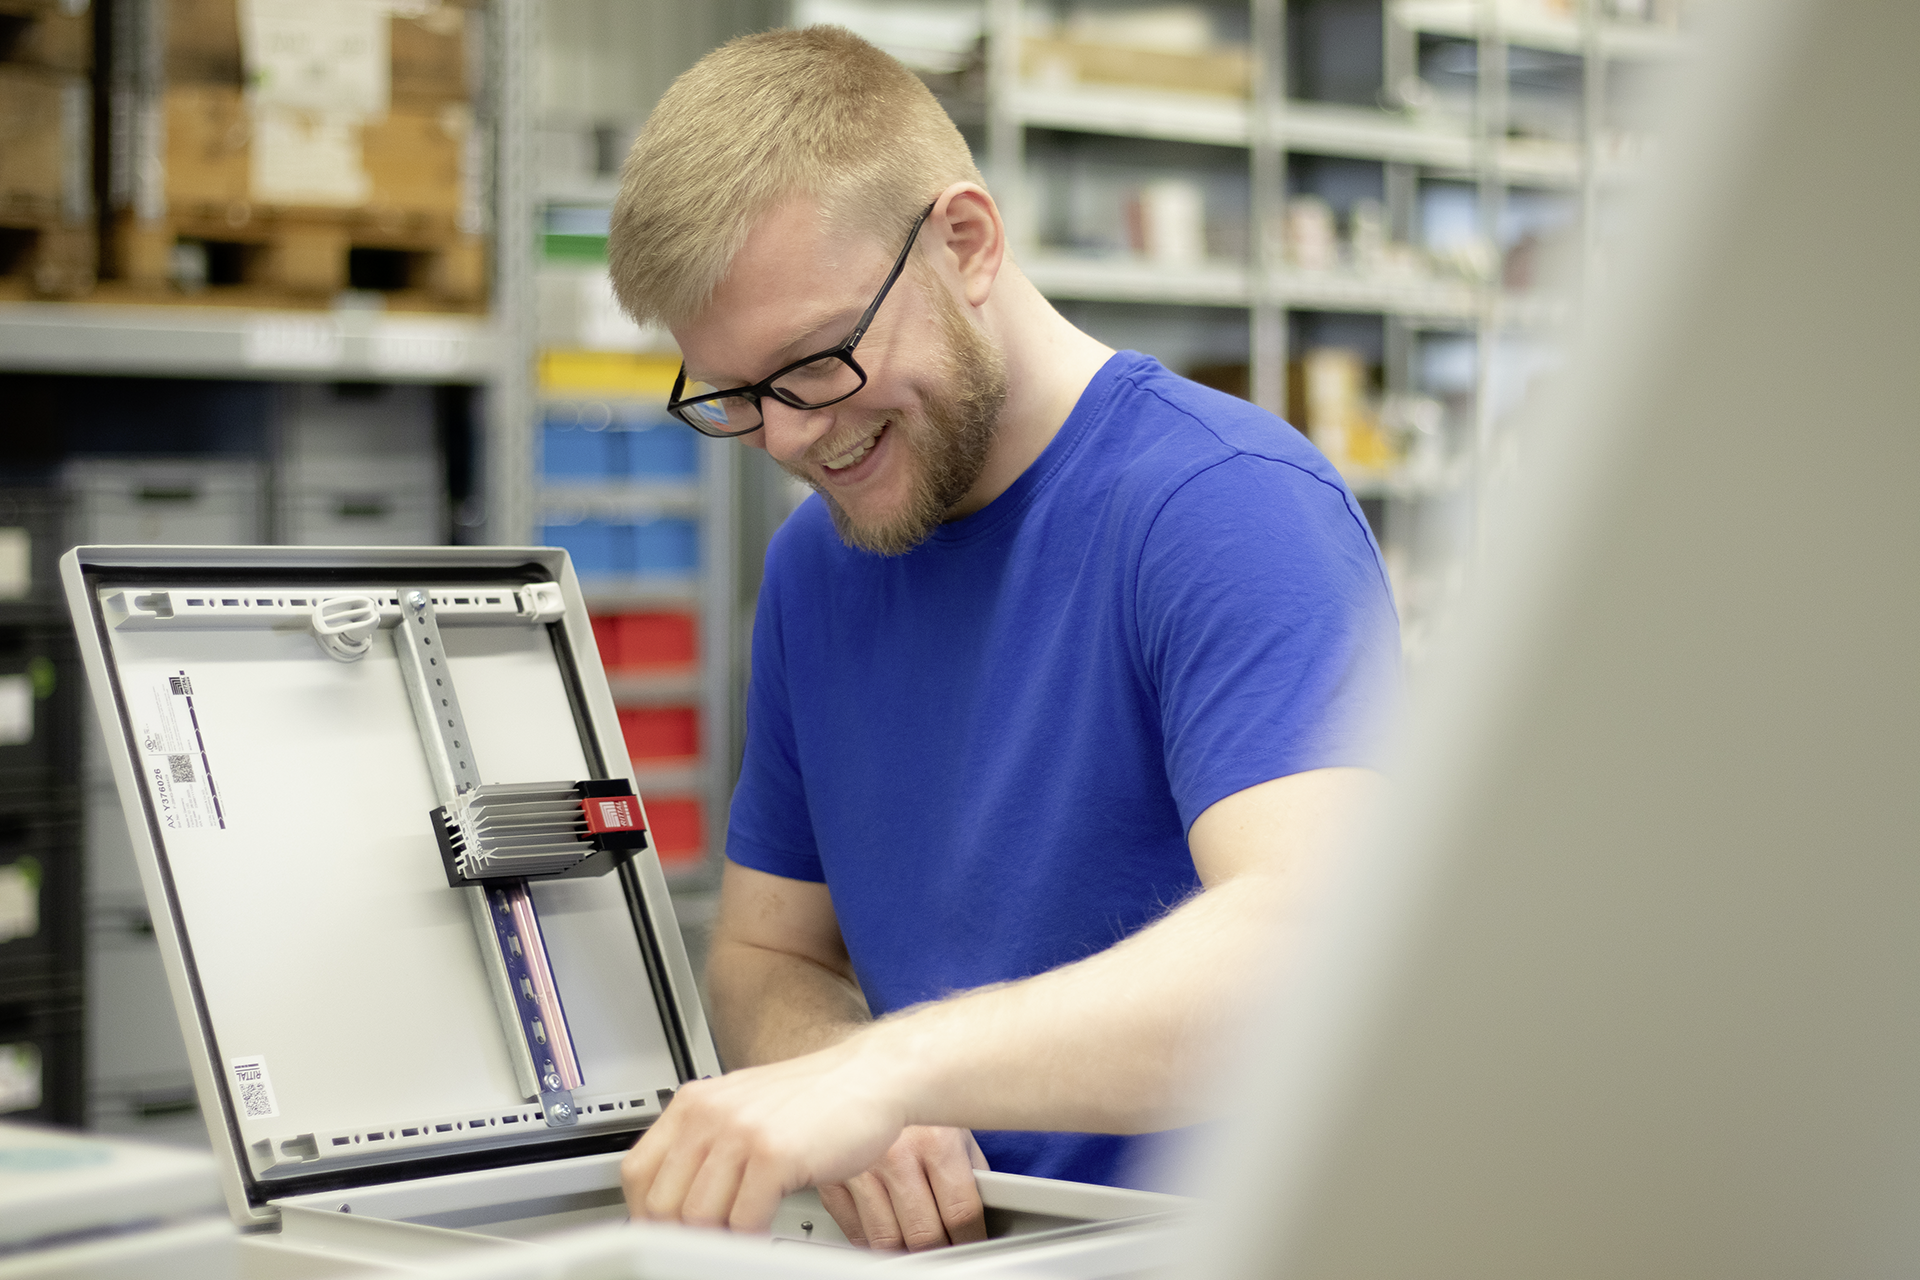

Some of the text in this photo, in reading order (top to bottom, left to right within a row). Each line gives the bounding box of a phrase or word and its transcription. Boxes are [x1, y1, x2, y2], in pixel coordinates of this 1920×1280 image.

[181, 677, 190, 695] RITTAL
[153, 768, 171, 812] Y376026
[166, 814, 176, 829] AX
[615, 801, 627, 827] RITTAL
[236, 1070, 262, 1081] RITTAL
